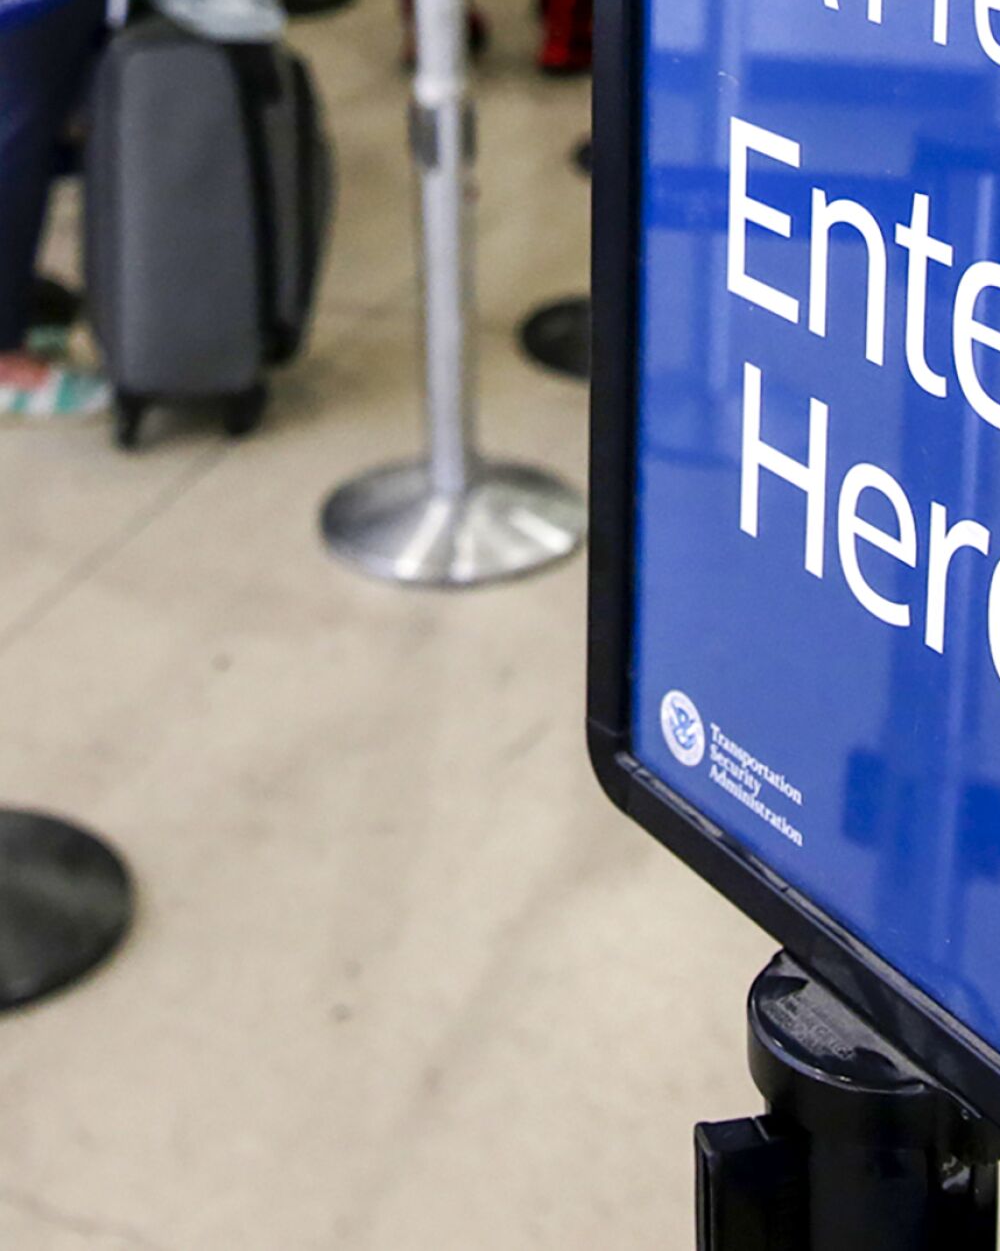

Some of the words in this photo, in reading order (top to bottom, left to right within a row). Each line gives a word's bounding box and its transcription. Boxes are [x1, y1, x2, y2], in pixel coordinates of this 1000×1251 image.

[708, 763, 804, 848] Administration
[709, 721, 804, 807] Transportation
[709, 743, 763, 797] Security
